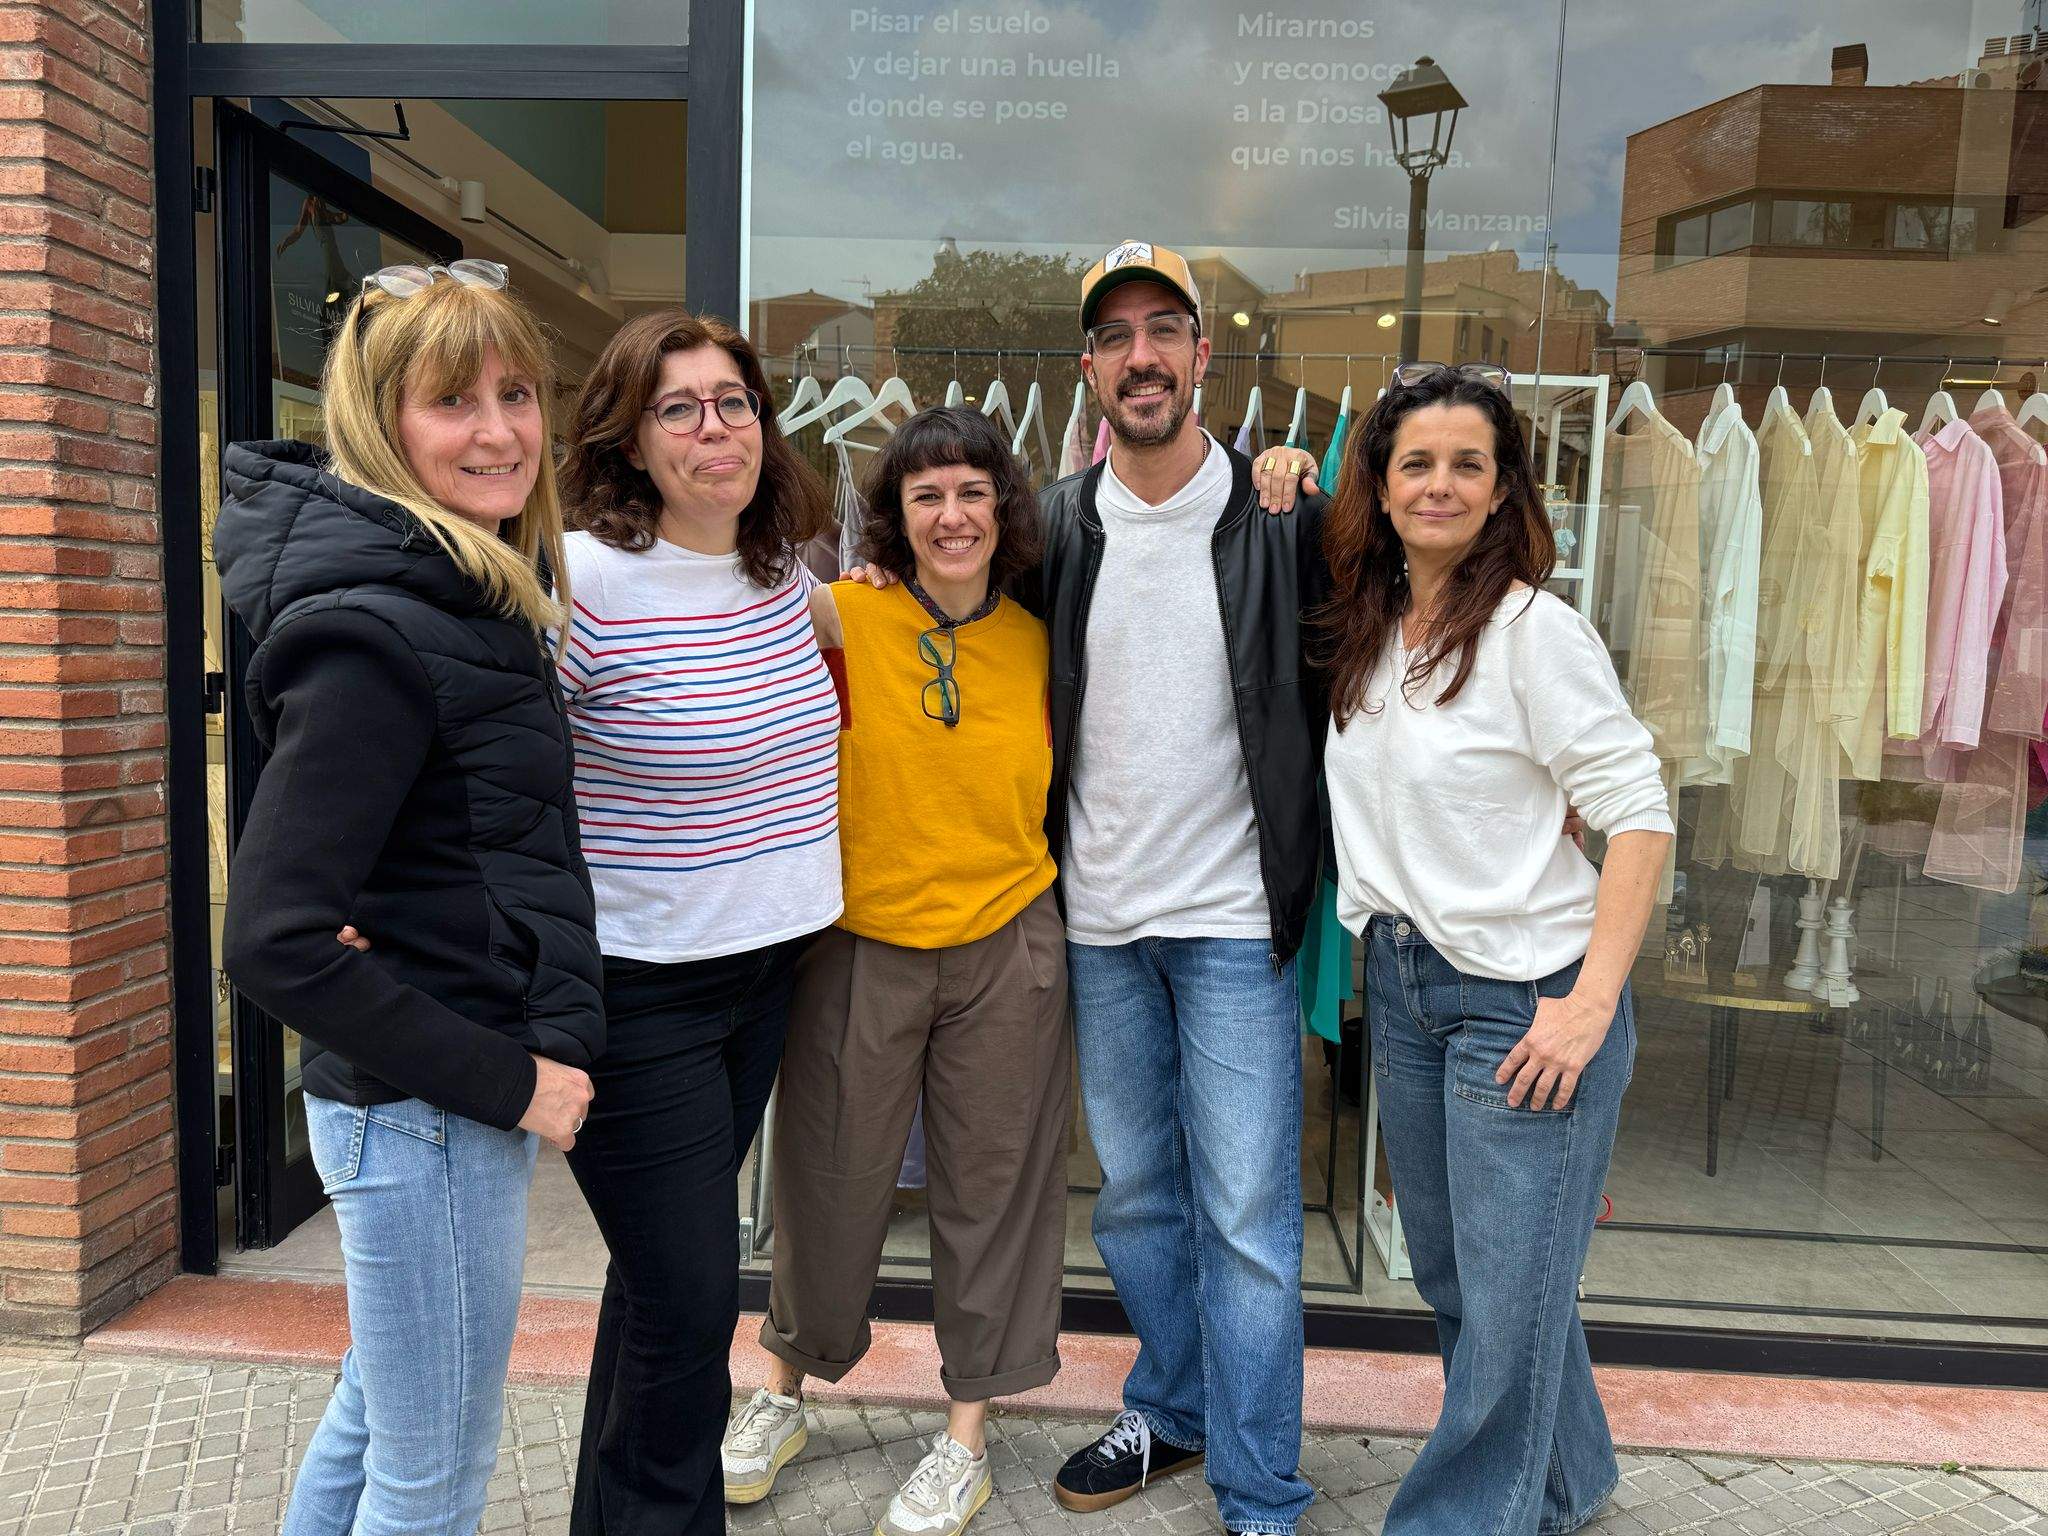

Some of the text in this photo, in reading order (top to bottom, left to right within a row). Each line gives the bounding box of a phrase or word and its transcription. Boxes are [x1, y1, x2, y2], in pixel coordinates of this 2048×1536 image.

[850, 8, 1051, 35] Pisar el suelo
[1237, 12, 1375, 39] Mirarnos
[847, 51, 1121, 82] y dejar una huella
[1233, 61, 1252, 85] y
[847, 93, 1068, 125] donde se pose
[1233, 99, 1383, 125] a la Diosa
[846, 135, 964, 165] el agua.
[1231, 148, 1290, 170] que
[1300, 147, 1355, 167] nos
[1334, 206, 1409, 230] Silvia
[288, 292, 323, 317] SILVIA
